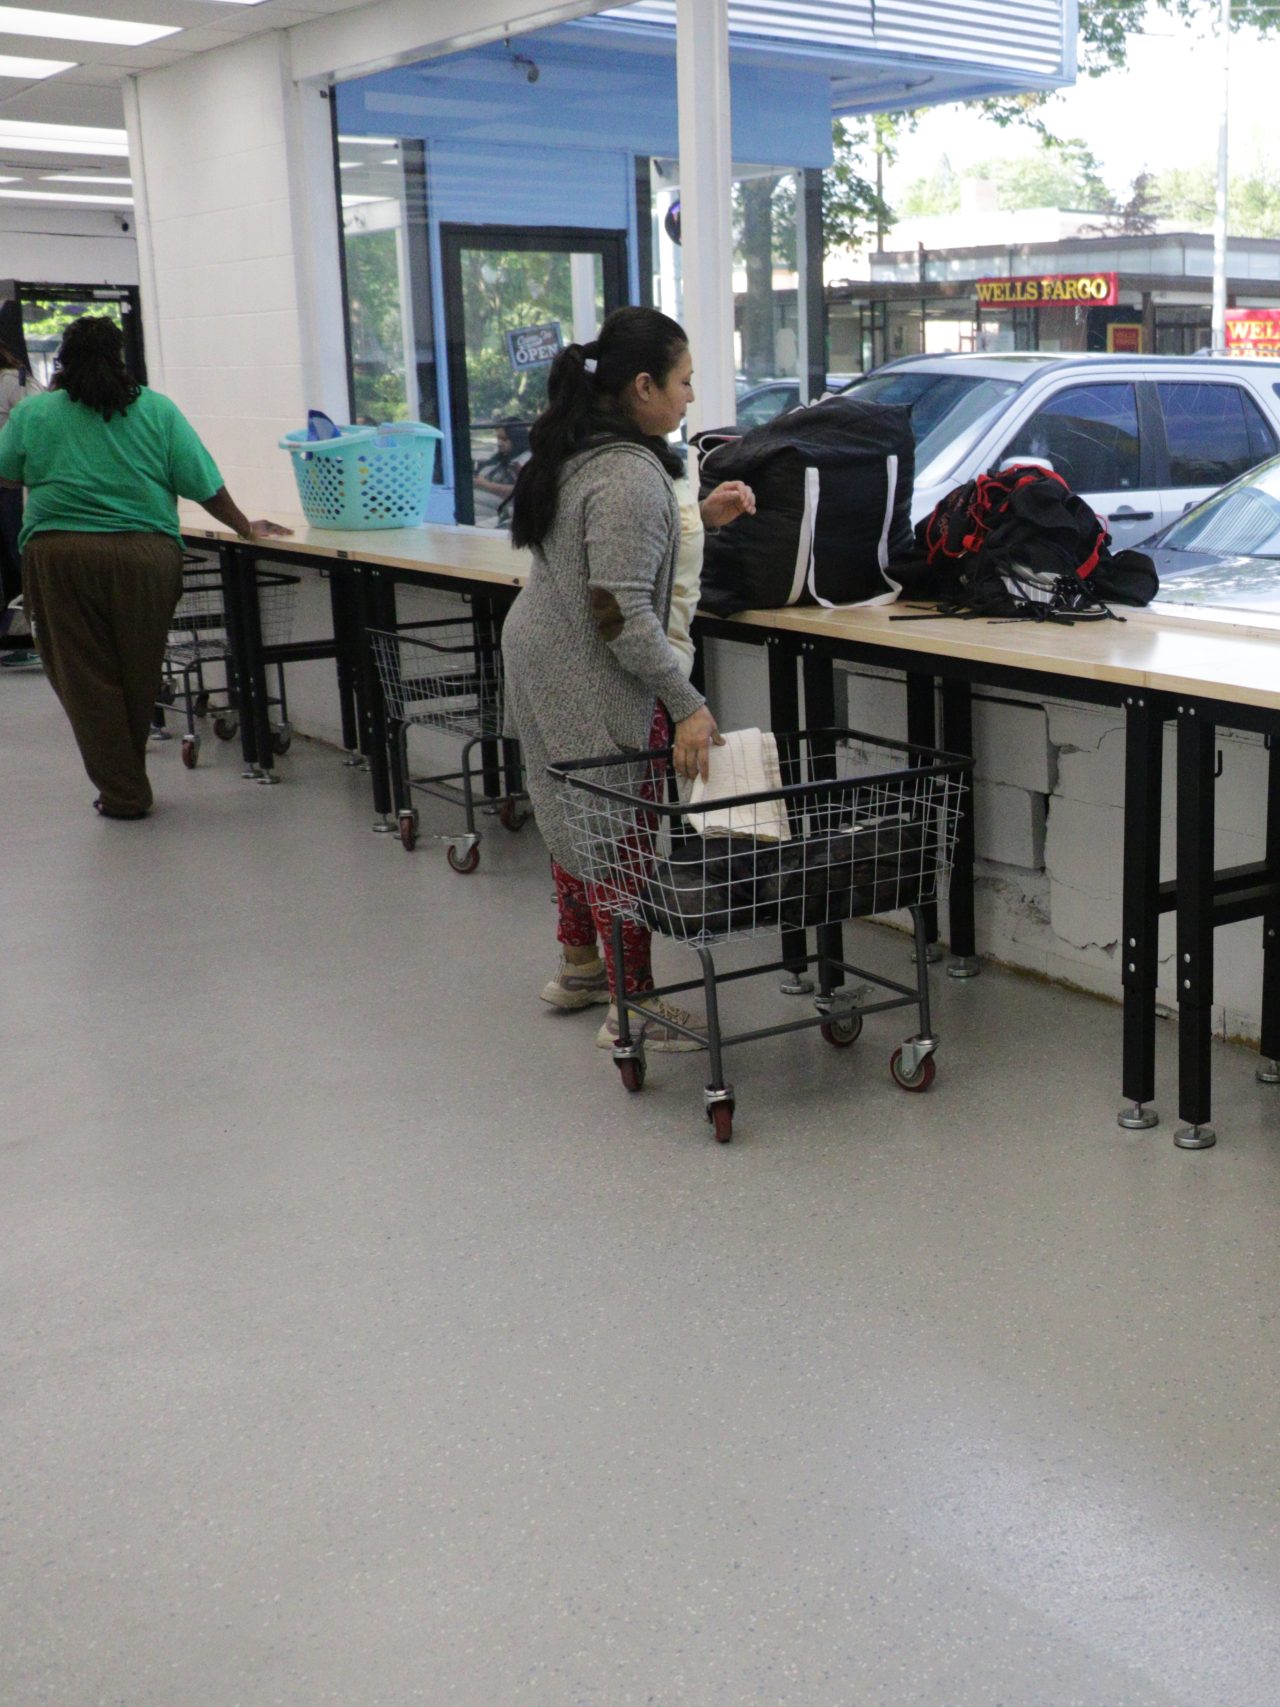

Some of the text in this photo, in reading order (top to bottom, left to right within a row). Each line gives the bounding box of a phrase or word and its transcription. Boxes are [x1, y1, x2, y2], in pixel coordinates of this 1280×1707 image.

[976, 278, 1107, 301] WELLS FARGO
[516, 344, 559, 363] OPEN
